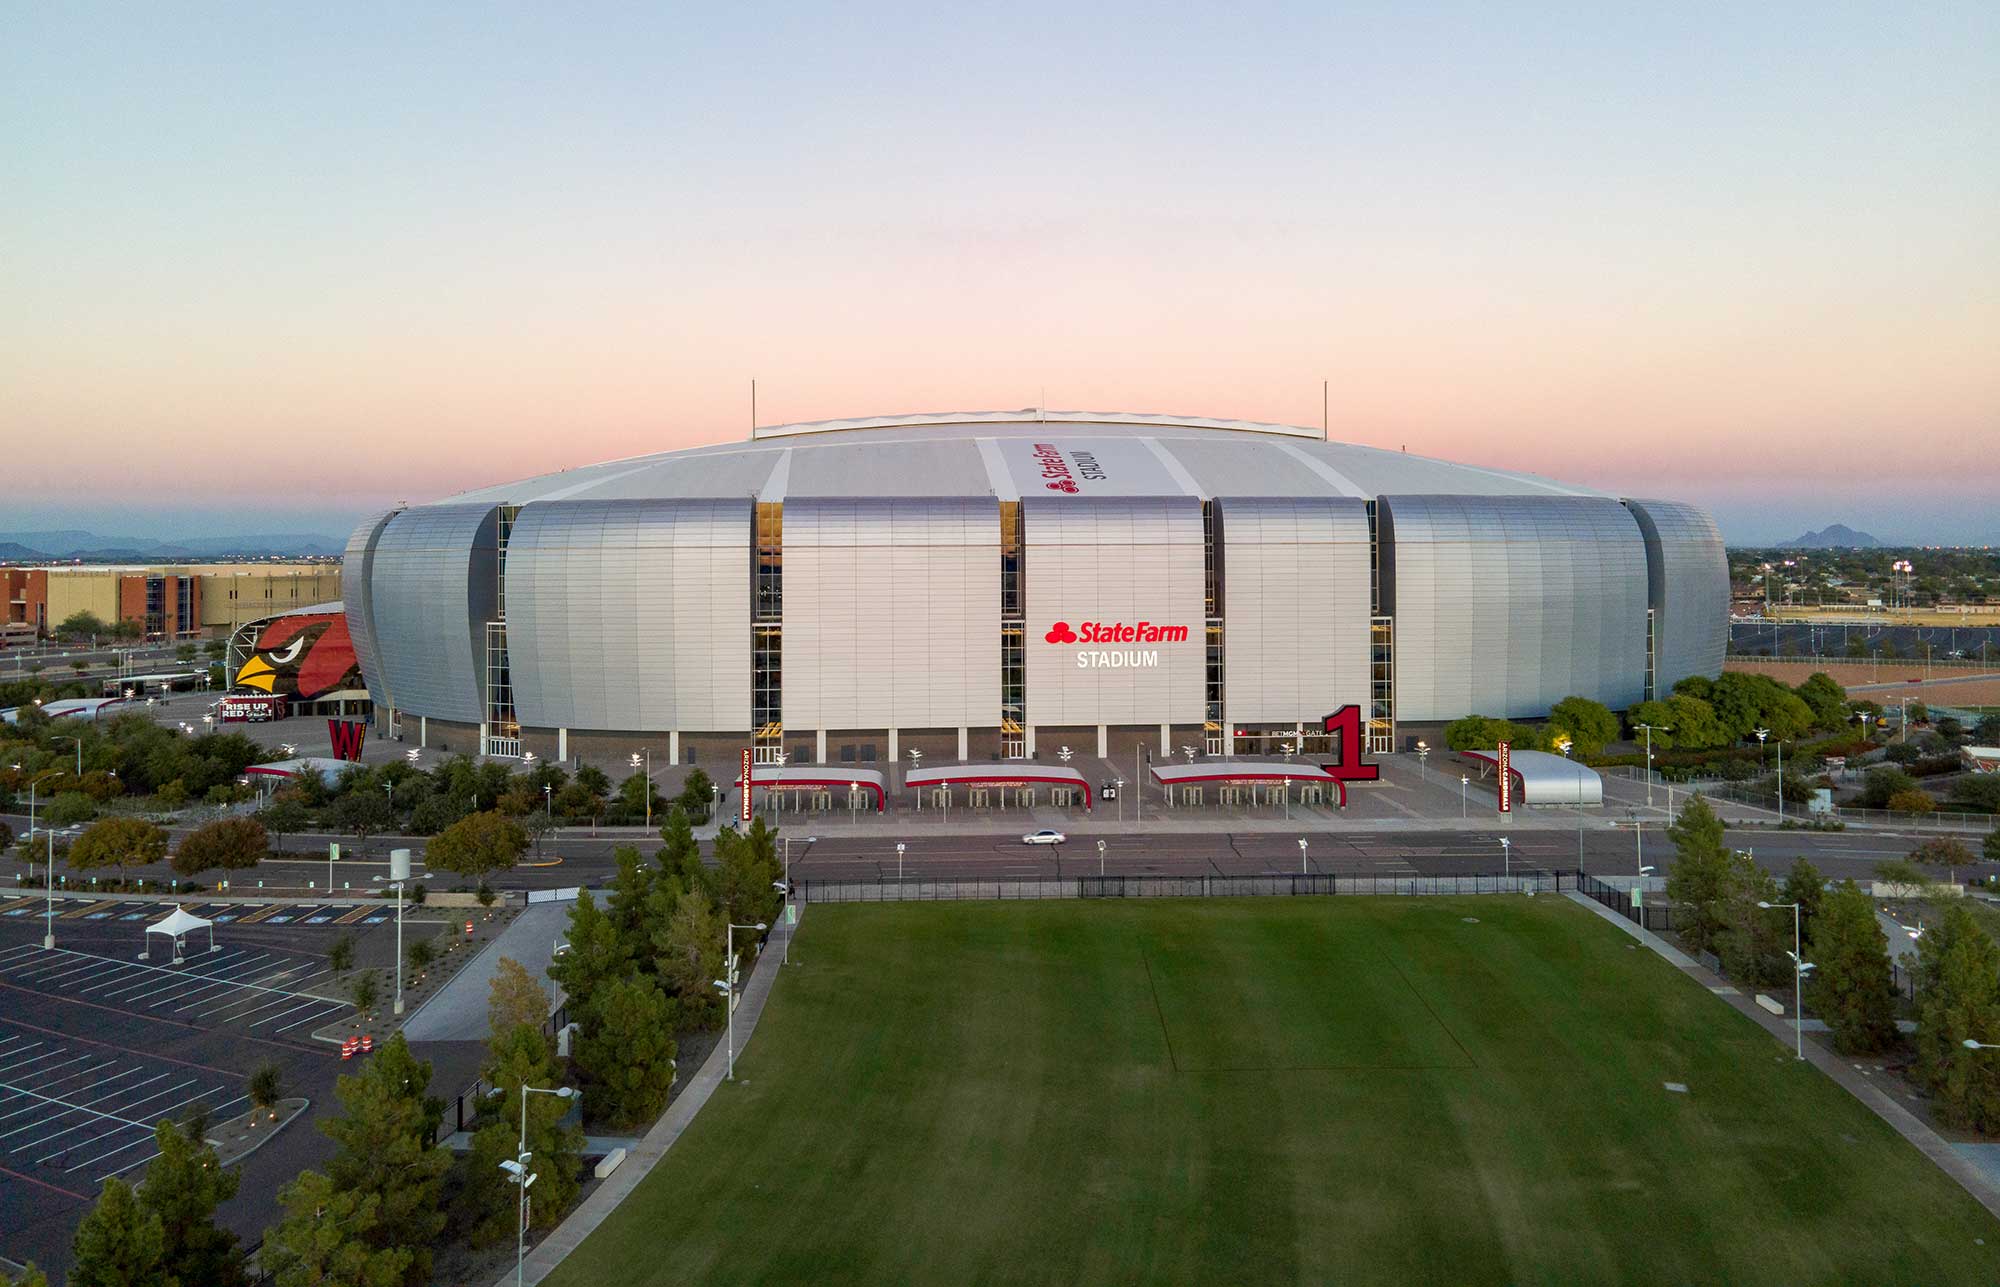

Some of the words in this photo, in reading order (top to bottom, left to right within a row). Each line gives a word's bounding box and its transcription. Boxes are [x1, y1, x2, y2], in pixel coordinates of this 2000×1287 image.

[1069, 451, 1107, 480] STADIUM
[1077, 650, 1158, 668] STADIUM
[328, 719, 367, 763] W
[1321, 704, 1379, 780] 1
